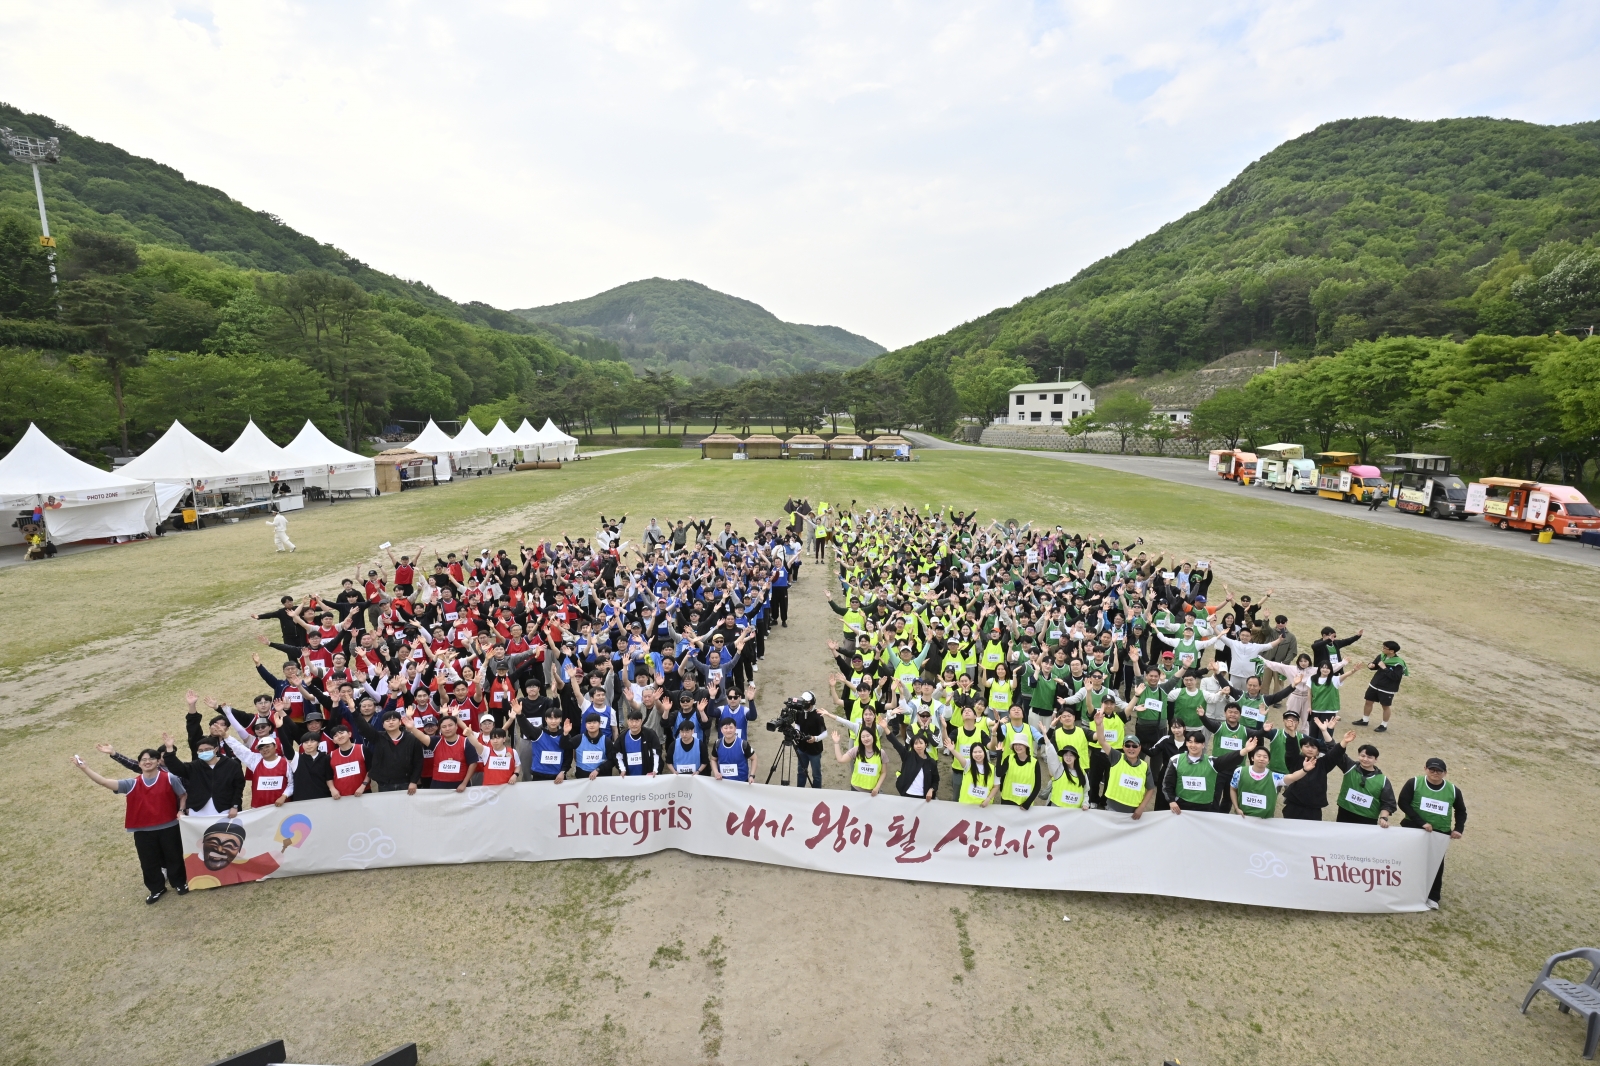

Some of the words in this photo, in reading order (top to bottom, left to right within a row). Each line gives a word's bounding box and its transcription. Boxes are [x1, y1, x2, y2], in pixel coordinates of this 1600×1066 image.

[587, 794, 608, 803] 2026
[610, 793, 646, 803] Entegris
[648, 792, 676, 801] Sports
[677, 790, 693, 800] Day
[558, 800, 692, 846] Entegris
[726, 805, 794, 840] 내가
[804, 801, 873, 852] 왕이
[886, 815, 932, 863] 될
[933, 819, 1060, 860] 상인가?
[1311, 856, 1402, 893] Entegris
[1346, 855, 1371, 863] Entegris
